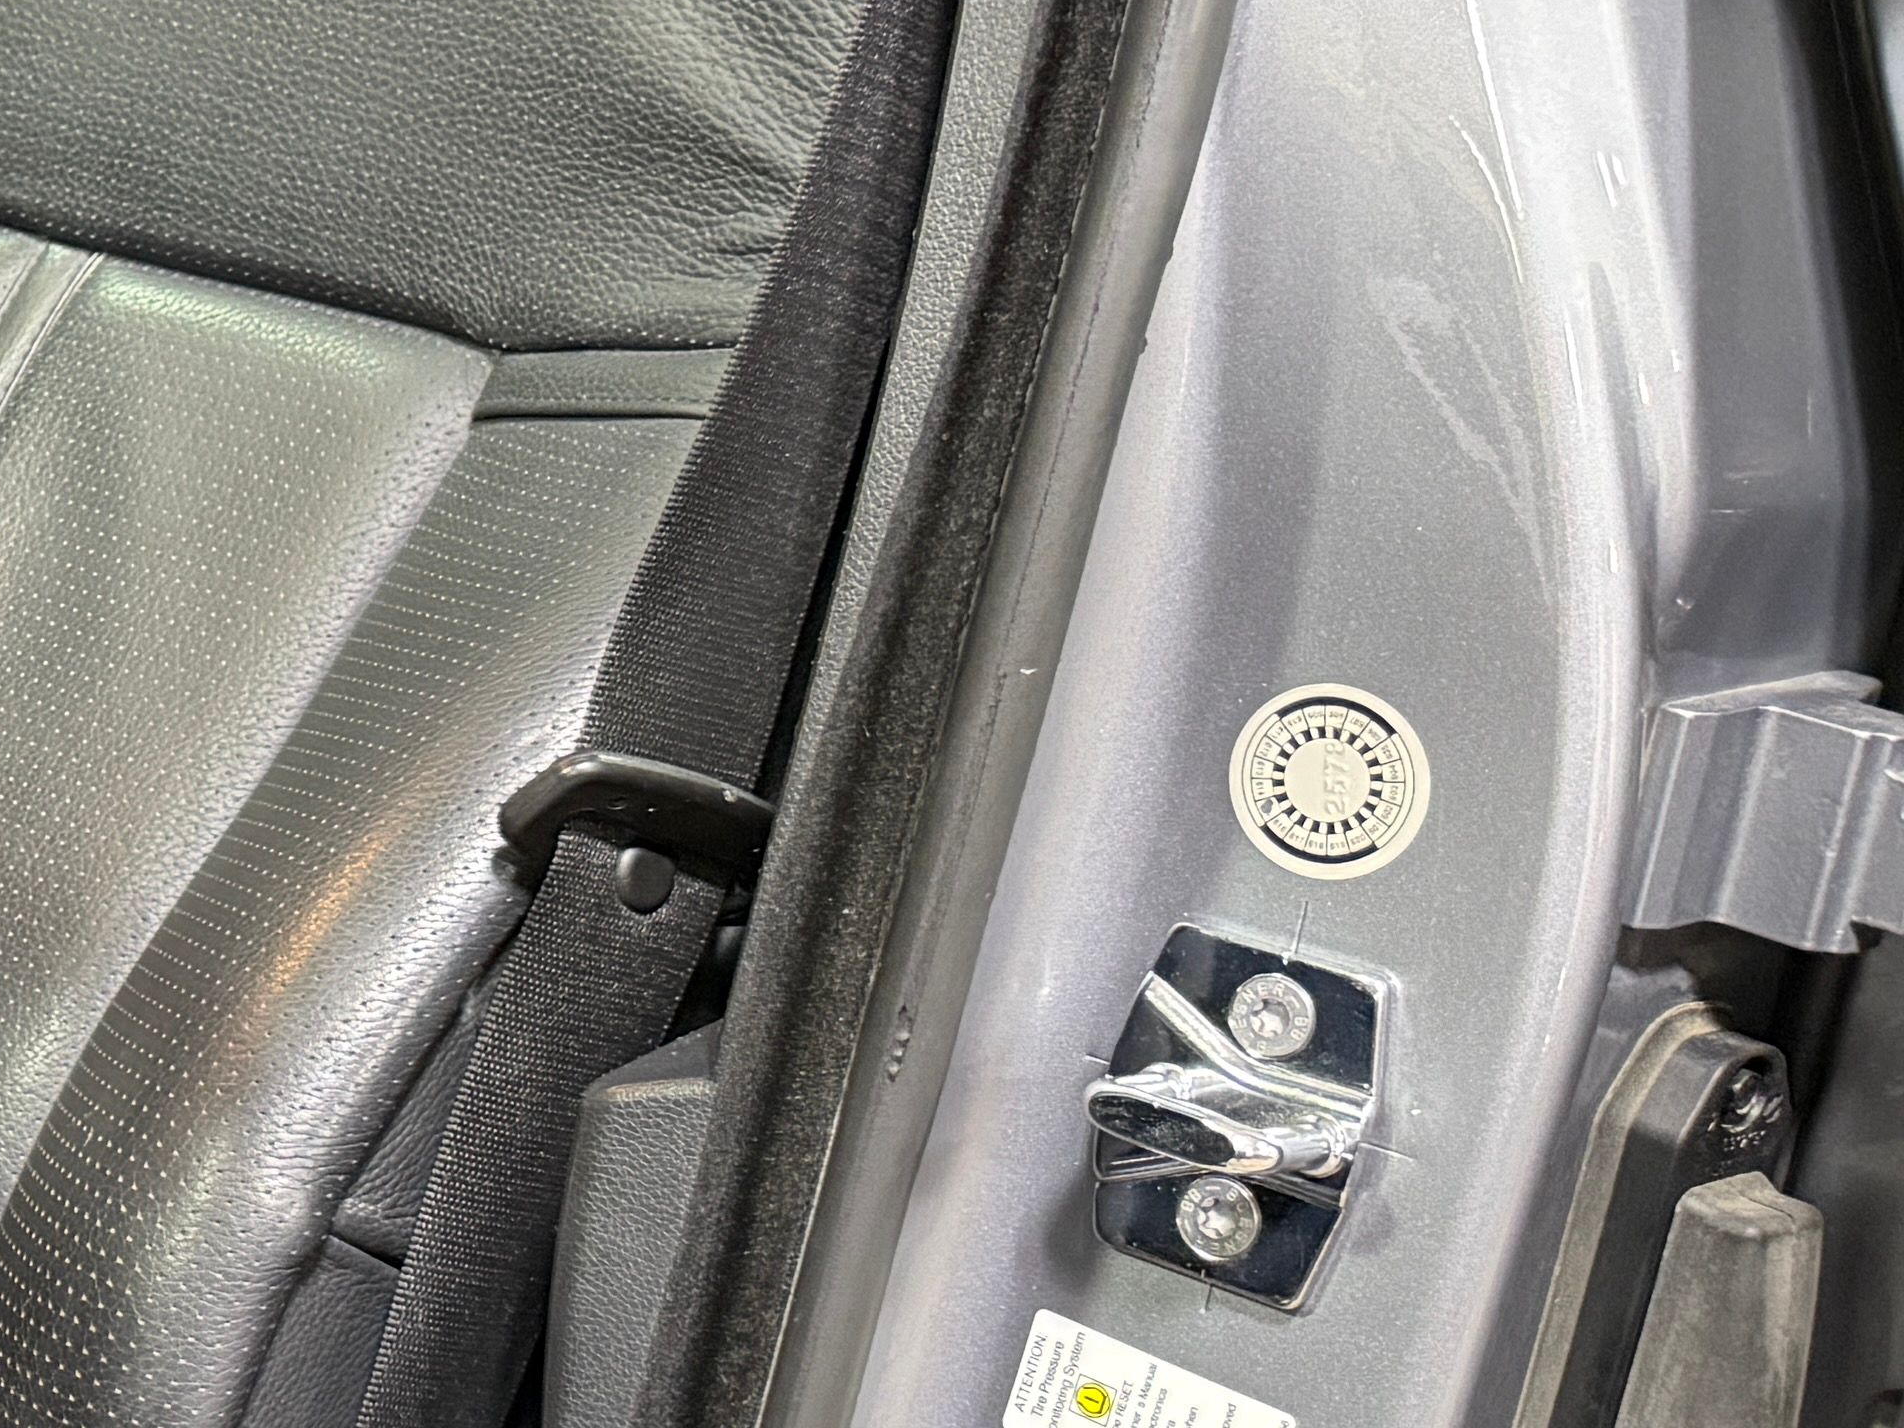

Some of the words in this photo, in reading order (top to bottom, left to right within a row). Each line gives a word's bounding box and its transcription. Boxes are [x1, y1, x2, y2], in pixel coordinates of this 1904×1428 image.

[1013, 1332, 1048, 1412] ATTENTION:
[1037, 1340, 1064, 1394] Pressure
[1063, 1331, 1086, 1376] System
[1137, 1362, 1157, 1399] Manual
[1029, 1395, 1047, 1416] Tire
